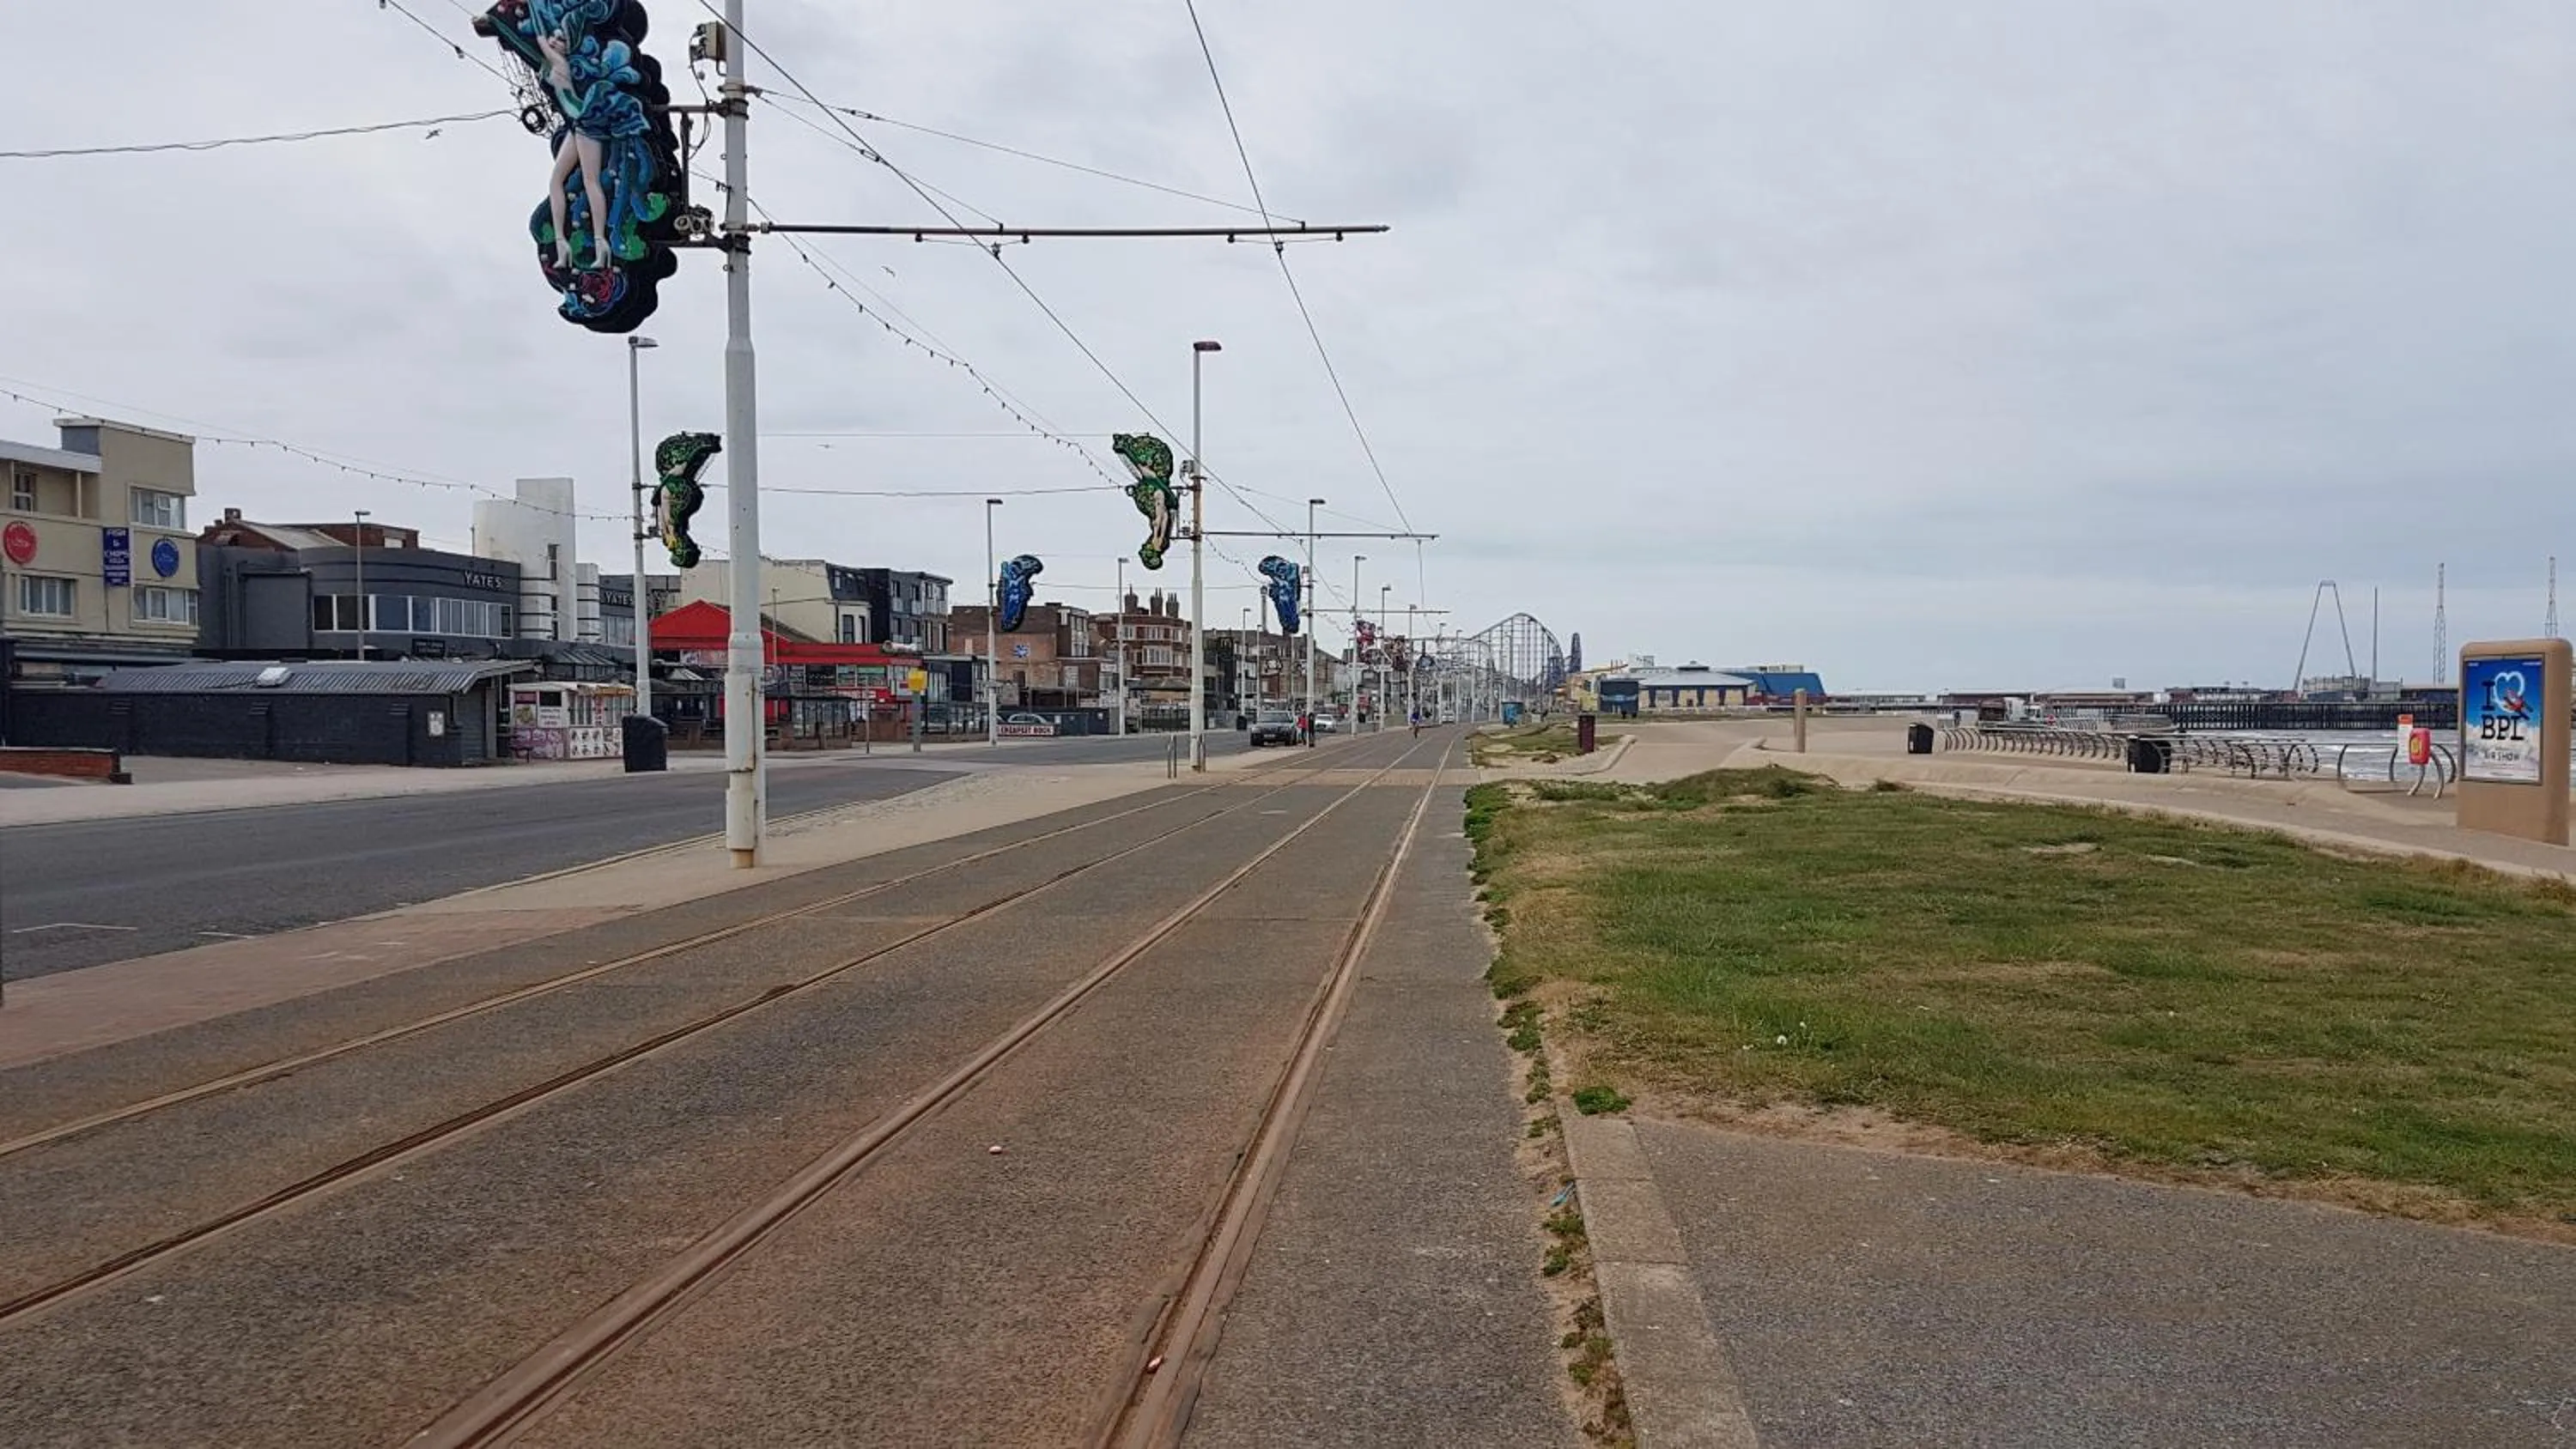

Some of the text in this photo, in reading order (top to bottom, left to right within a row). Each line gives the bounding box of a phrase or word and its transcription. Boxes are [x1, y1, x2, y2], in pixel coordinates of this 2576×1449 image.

[465, 570, 502, 589] YATES
[2481, 680, 2495, 711] I
[2481, 714, 2524, 740] BPL
